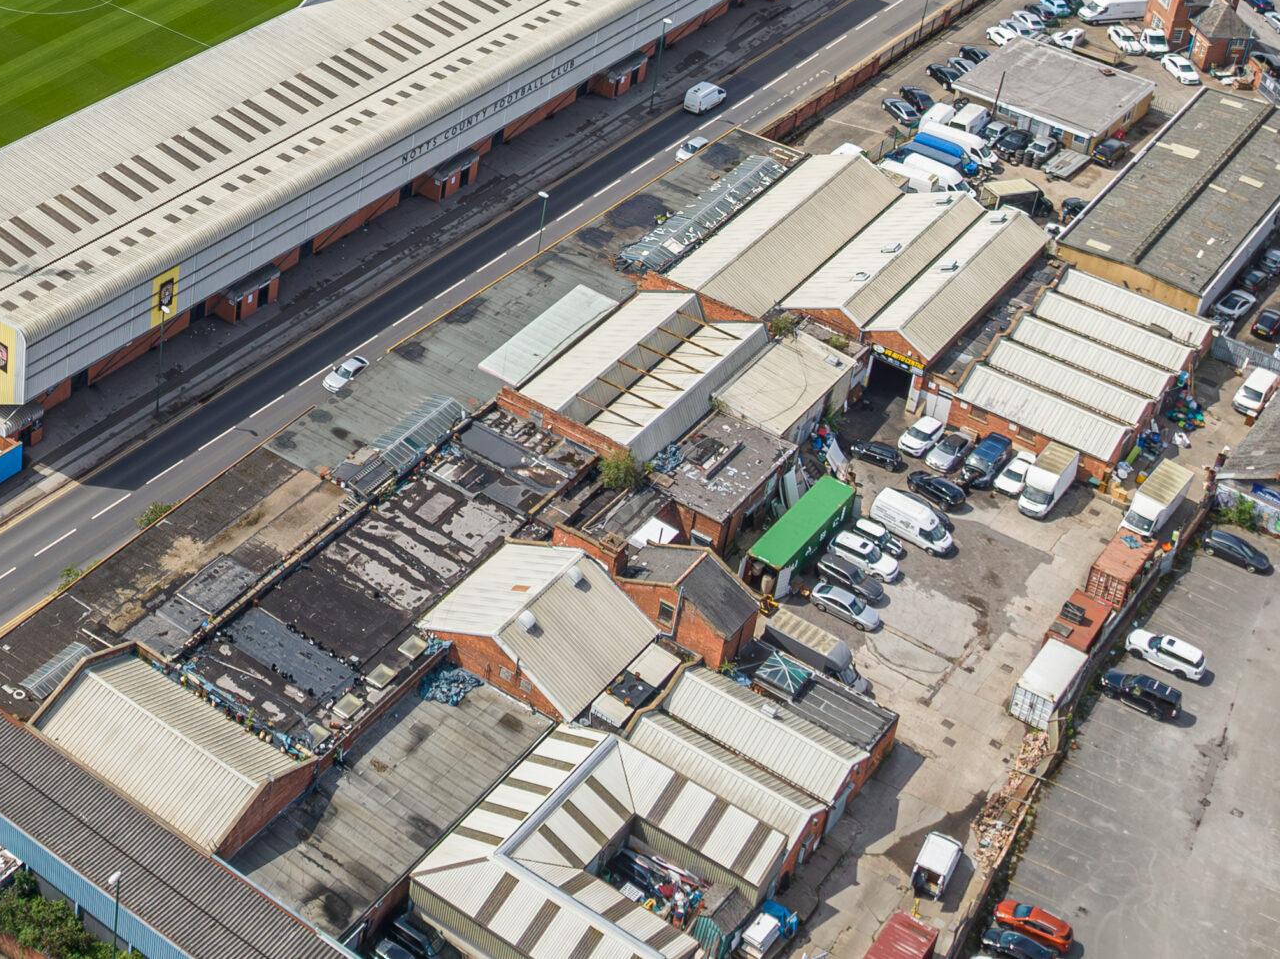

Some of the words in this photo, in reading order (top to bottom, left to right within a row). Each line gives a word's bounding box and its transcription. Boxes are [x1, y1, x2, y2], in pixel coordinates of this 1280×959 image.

[401, 135, 438, 164] NOTTS
[444, 108, 488, 140] COUNTY
[493, 75, 544, 112] FOOTBALL
[550, 58, 575, 79] CLUB
